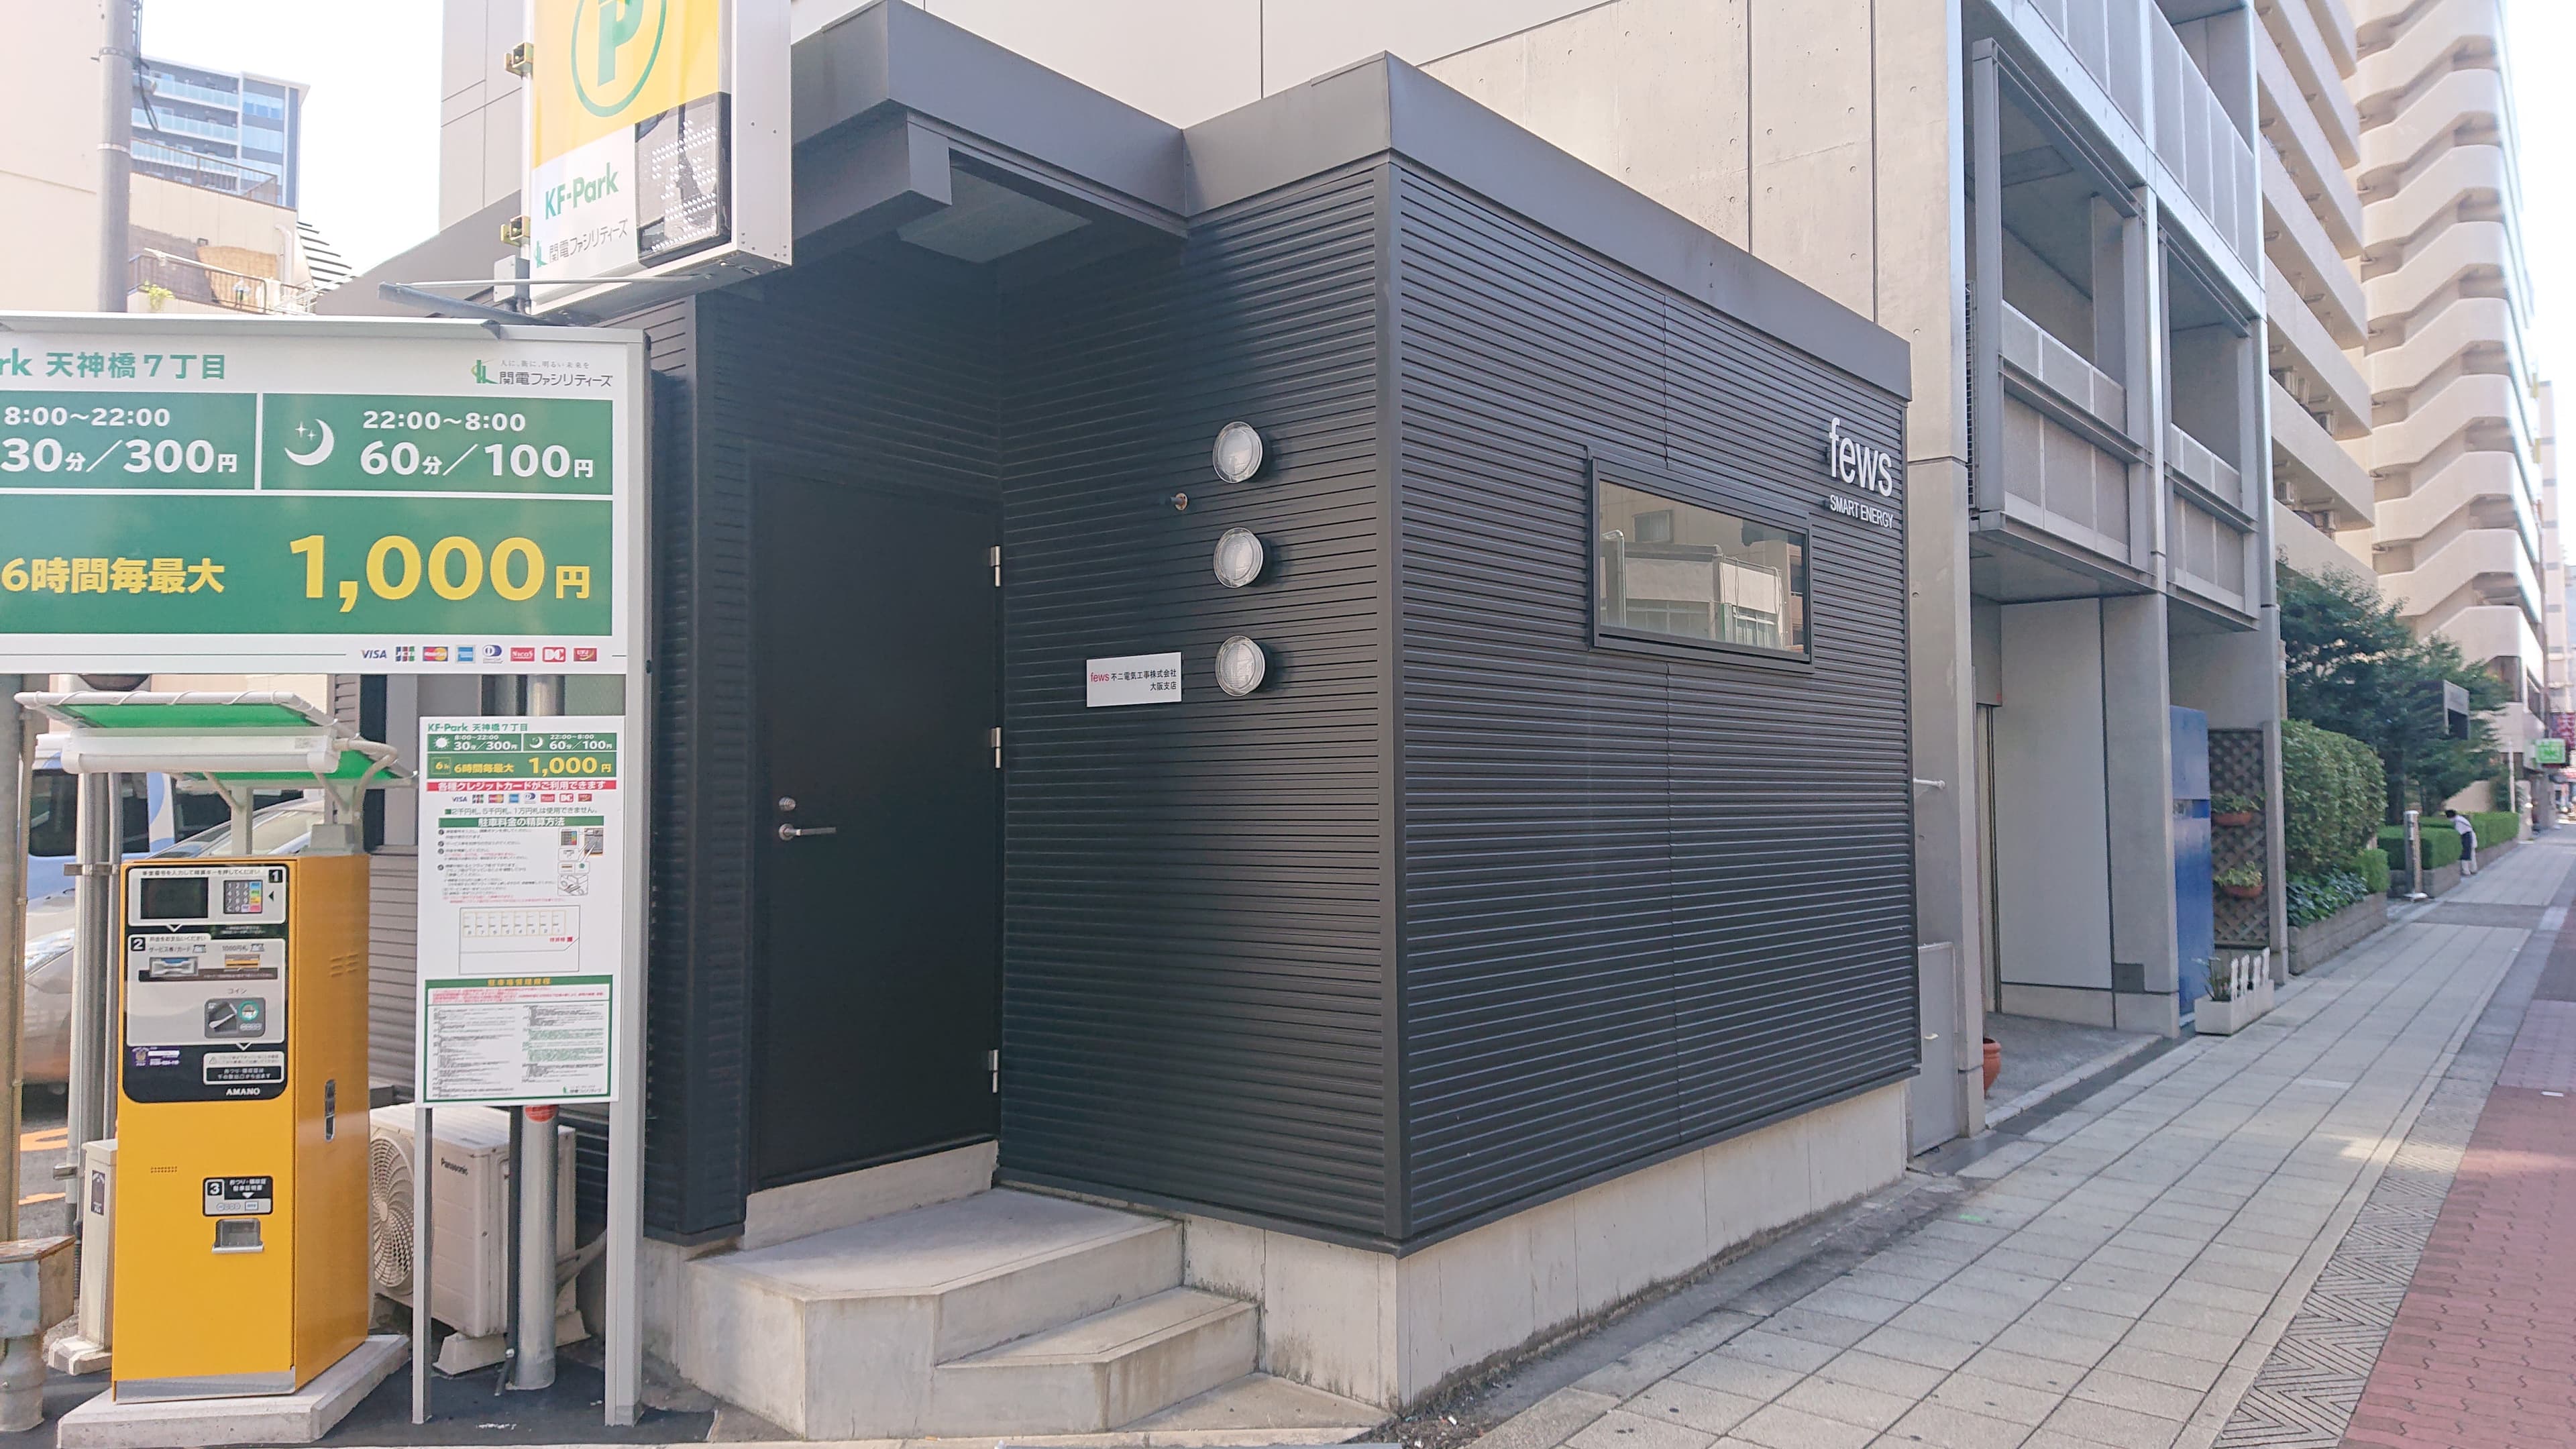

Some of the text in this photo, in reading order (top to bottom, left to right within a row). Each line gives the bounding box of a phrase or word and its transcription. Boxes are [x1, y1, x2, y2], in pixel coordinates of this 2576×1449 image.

[545, 162, 619, 220] KF-Park
[549, 218, 628, 263] 関電ファシリティーズ
[46, 352, 226, 380] 天神橋7丁目
[499, 371, 613, 387] 関電ファシリティーズ
[362, 410, 526, 431] 22:00～8:00
[1829, 417, 1892, 496] fews
[1830, 494, 1894, 529] SMART ENERGY
[1, 557, 225, 594] 6時間毎最大
[362, 649, 388, 659] VISA
[544, 648, 564, 661] DC
[1091, 669, 1177, 682] fews 不二電気工事株式会社
[1150, 682, 1177, 691] 大阪支店
[427, 722, 528, 732] KF-Park 天神橋7丁目
[437, 780, 606, 792] 各種クレジットカードがご利用できます
[272, 871, 279, 882] 1
[133, 938, 144, 950] 2
[225, 1087, 261, 1096] AMANO
[209, 1183, 220, 1195] 3
